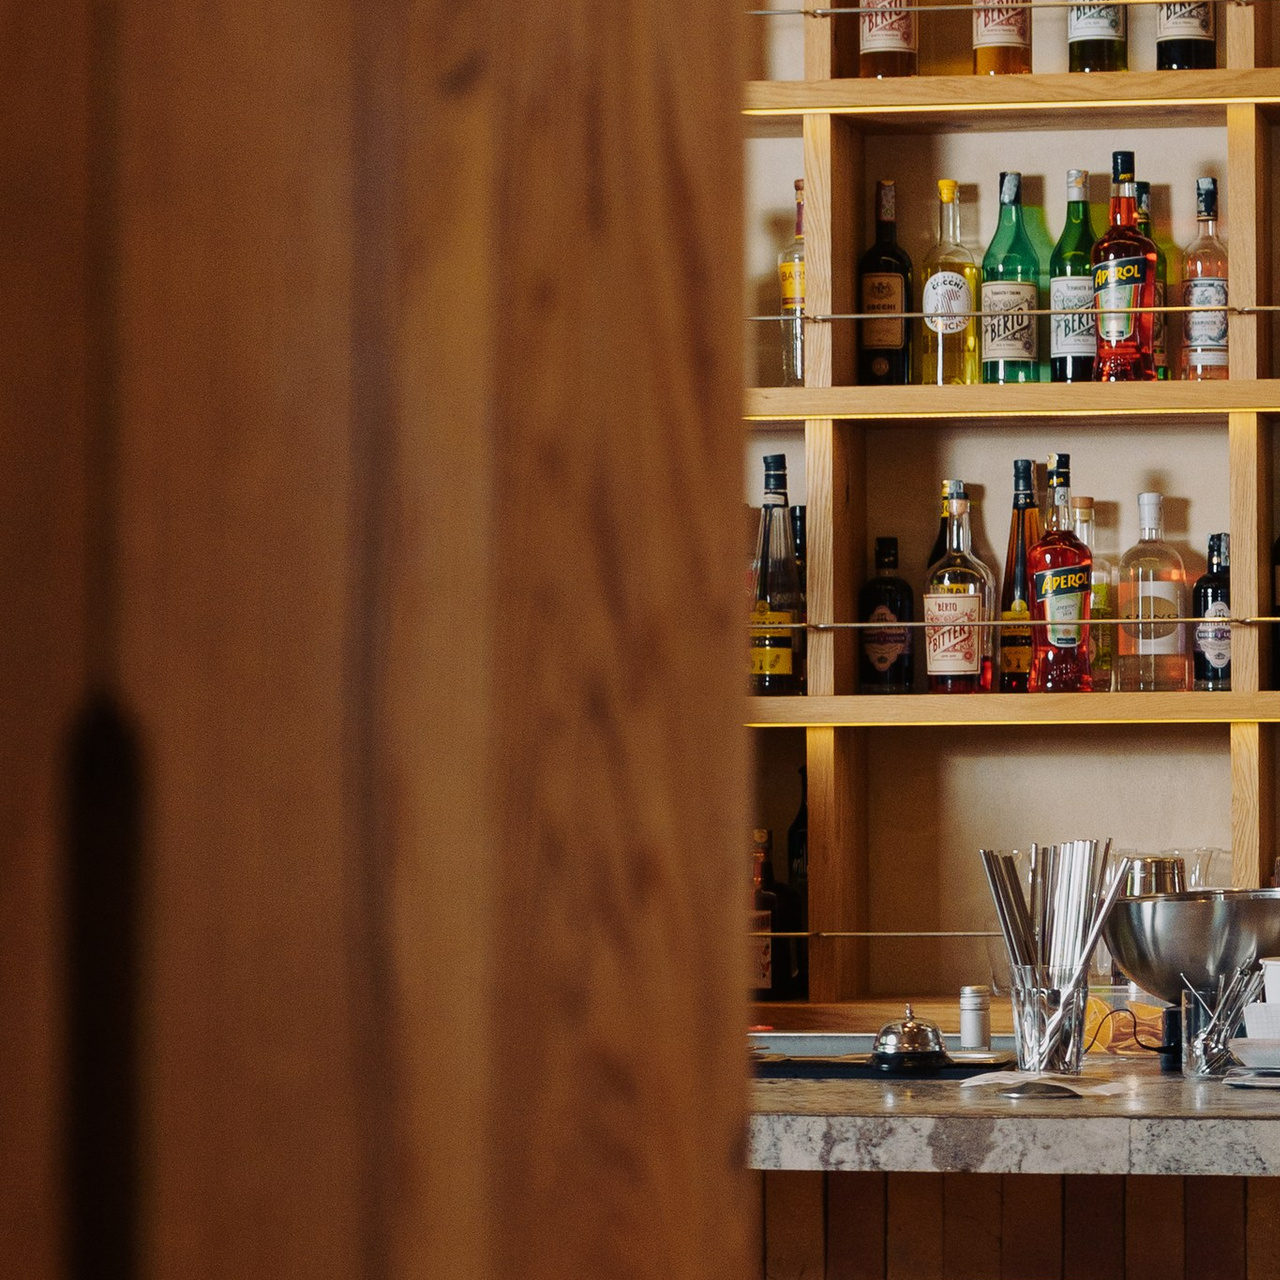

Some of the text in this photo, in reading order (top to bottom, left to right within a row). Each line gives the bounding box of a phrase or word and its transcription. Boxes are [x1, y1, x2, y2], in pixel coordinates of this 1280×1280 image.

[932, 279, 964, 291] COCCHI
[1094, 263, 1141, 289] APEROL
[990, 307, 1024, 343] BERTO
[1041, 572, 1089, 595] APEROL
[937, 602, 958, 612] BERTO
[931, 625, 967, 655] BITTER
